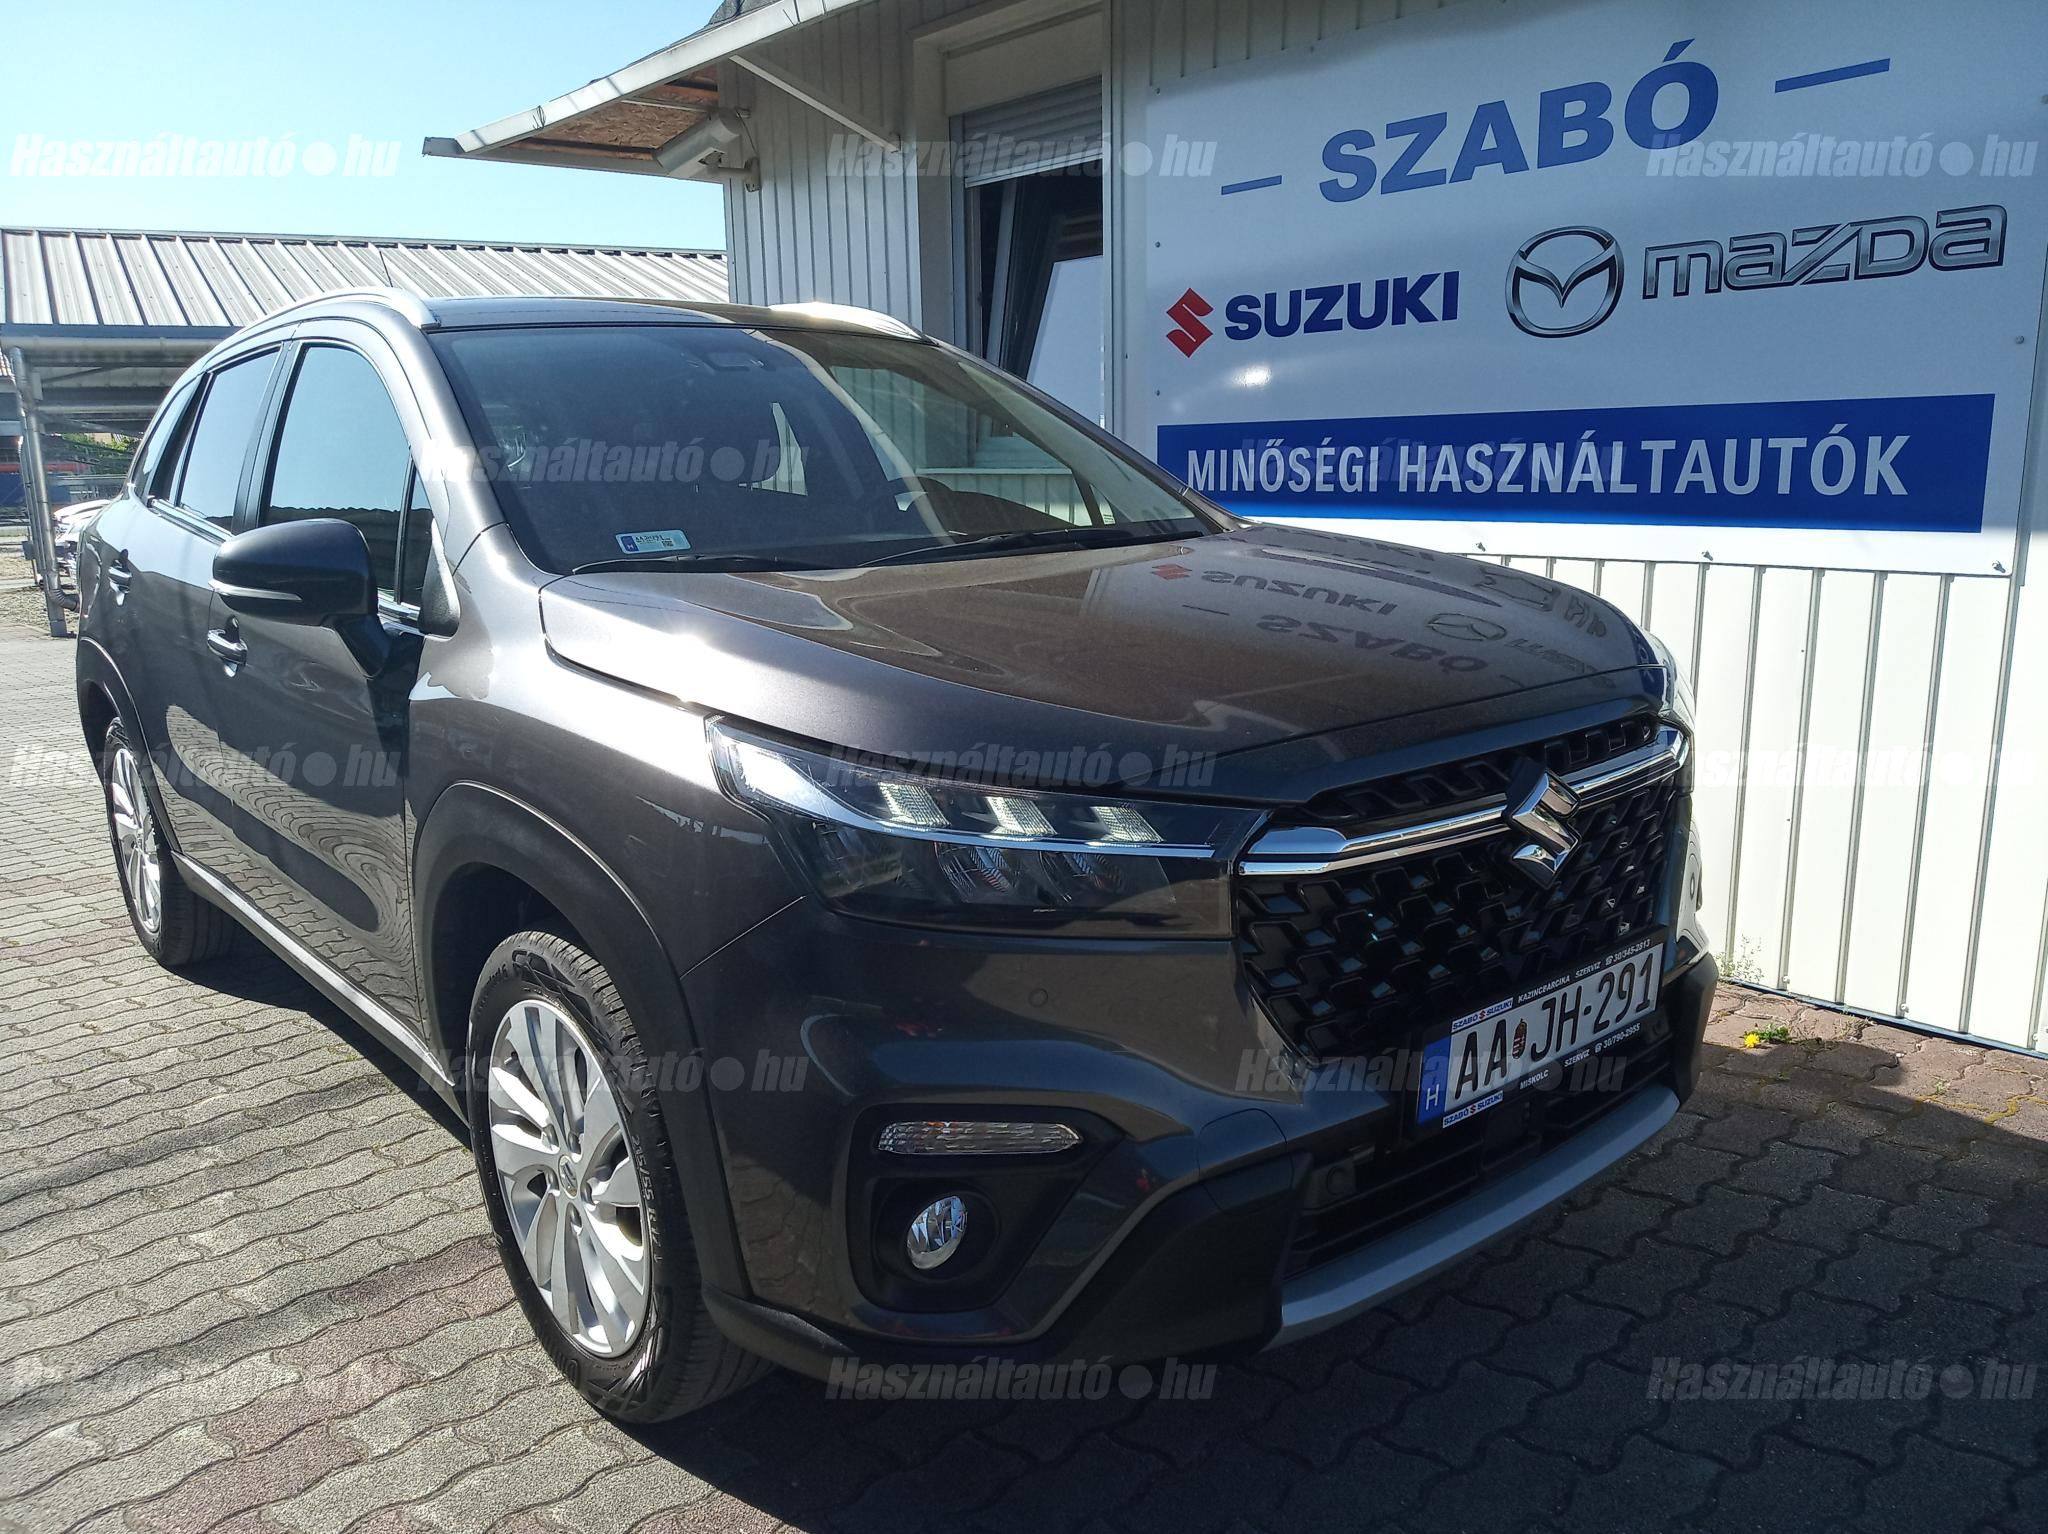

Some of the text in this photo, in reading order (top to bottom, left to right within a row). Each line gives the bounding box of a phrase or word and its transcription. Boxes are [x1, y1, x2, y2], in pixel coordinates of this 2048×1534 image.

[1318, 38, 1719, 203] SZABÓ
[1224, 270, 1459, 342] SUZUKI
[1187, 424, 1911, 496] MINŐSÉGI HASZNÁLTAUTÓK
[1575, 961, 1602, 978] SZERVIZ
[1519, 1068, 1549, 1090] MISKOLC
[1564, 1048, 1590, 1068] SZERVIZ
